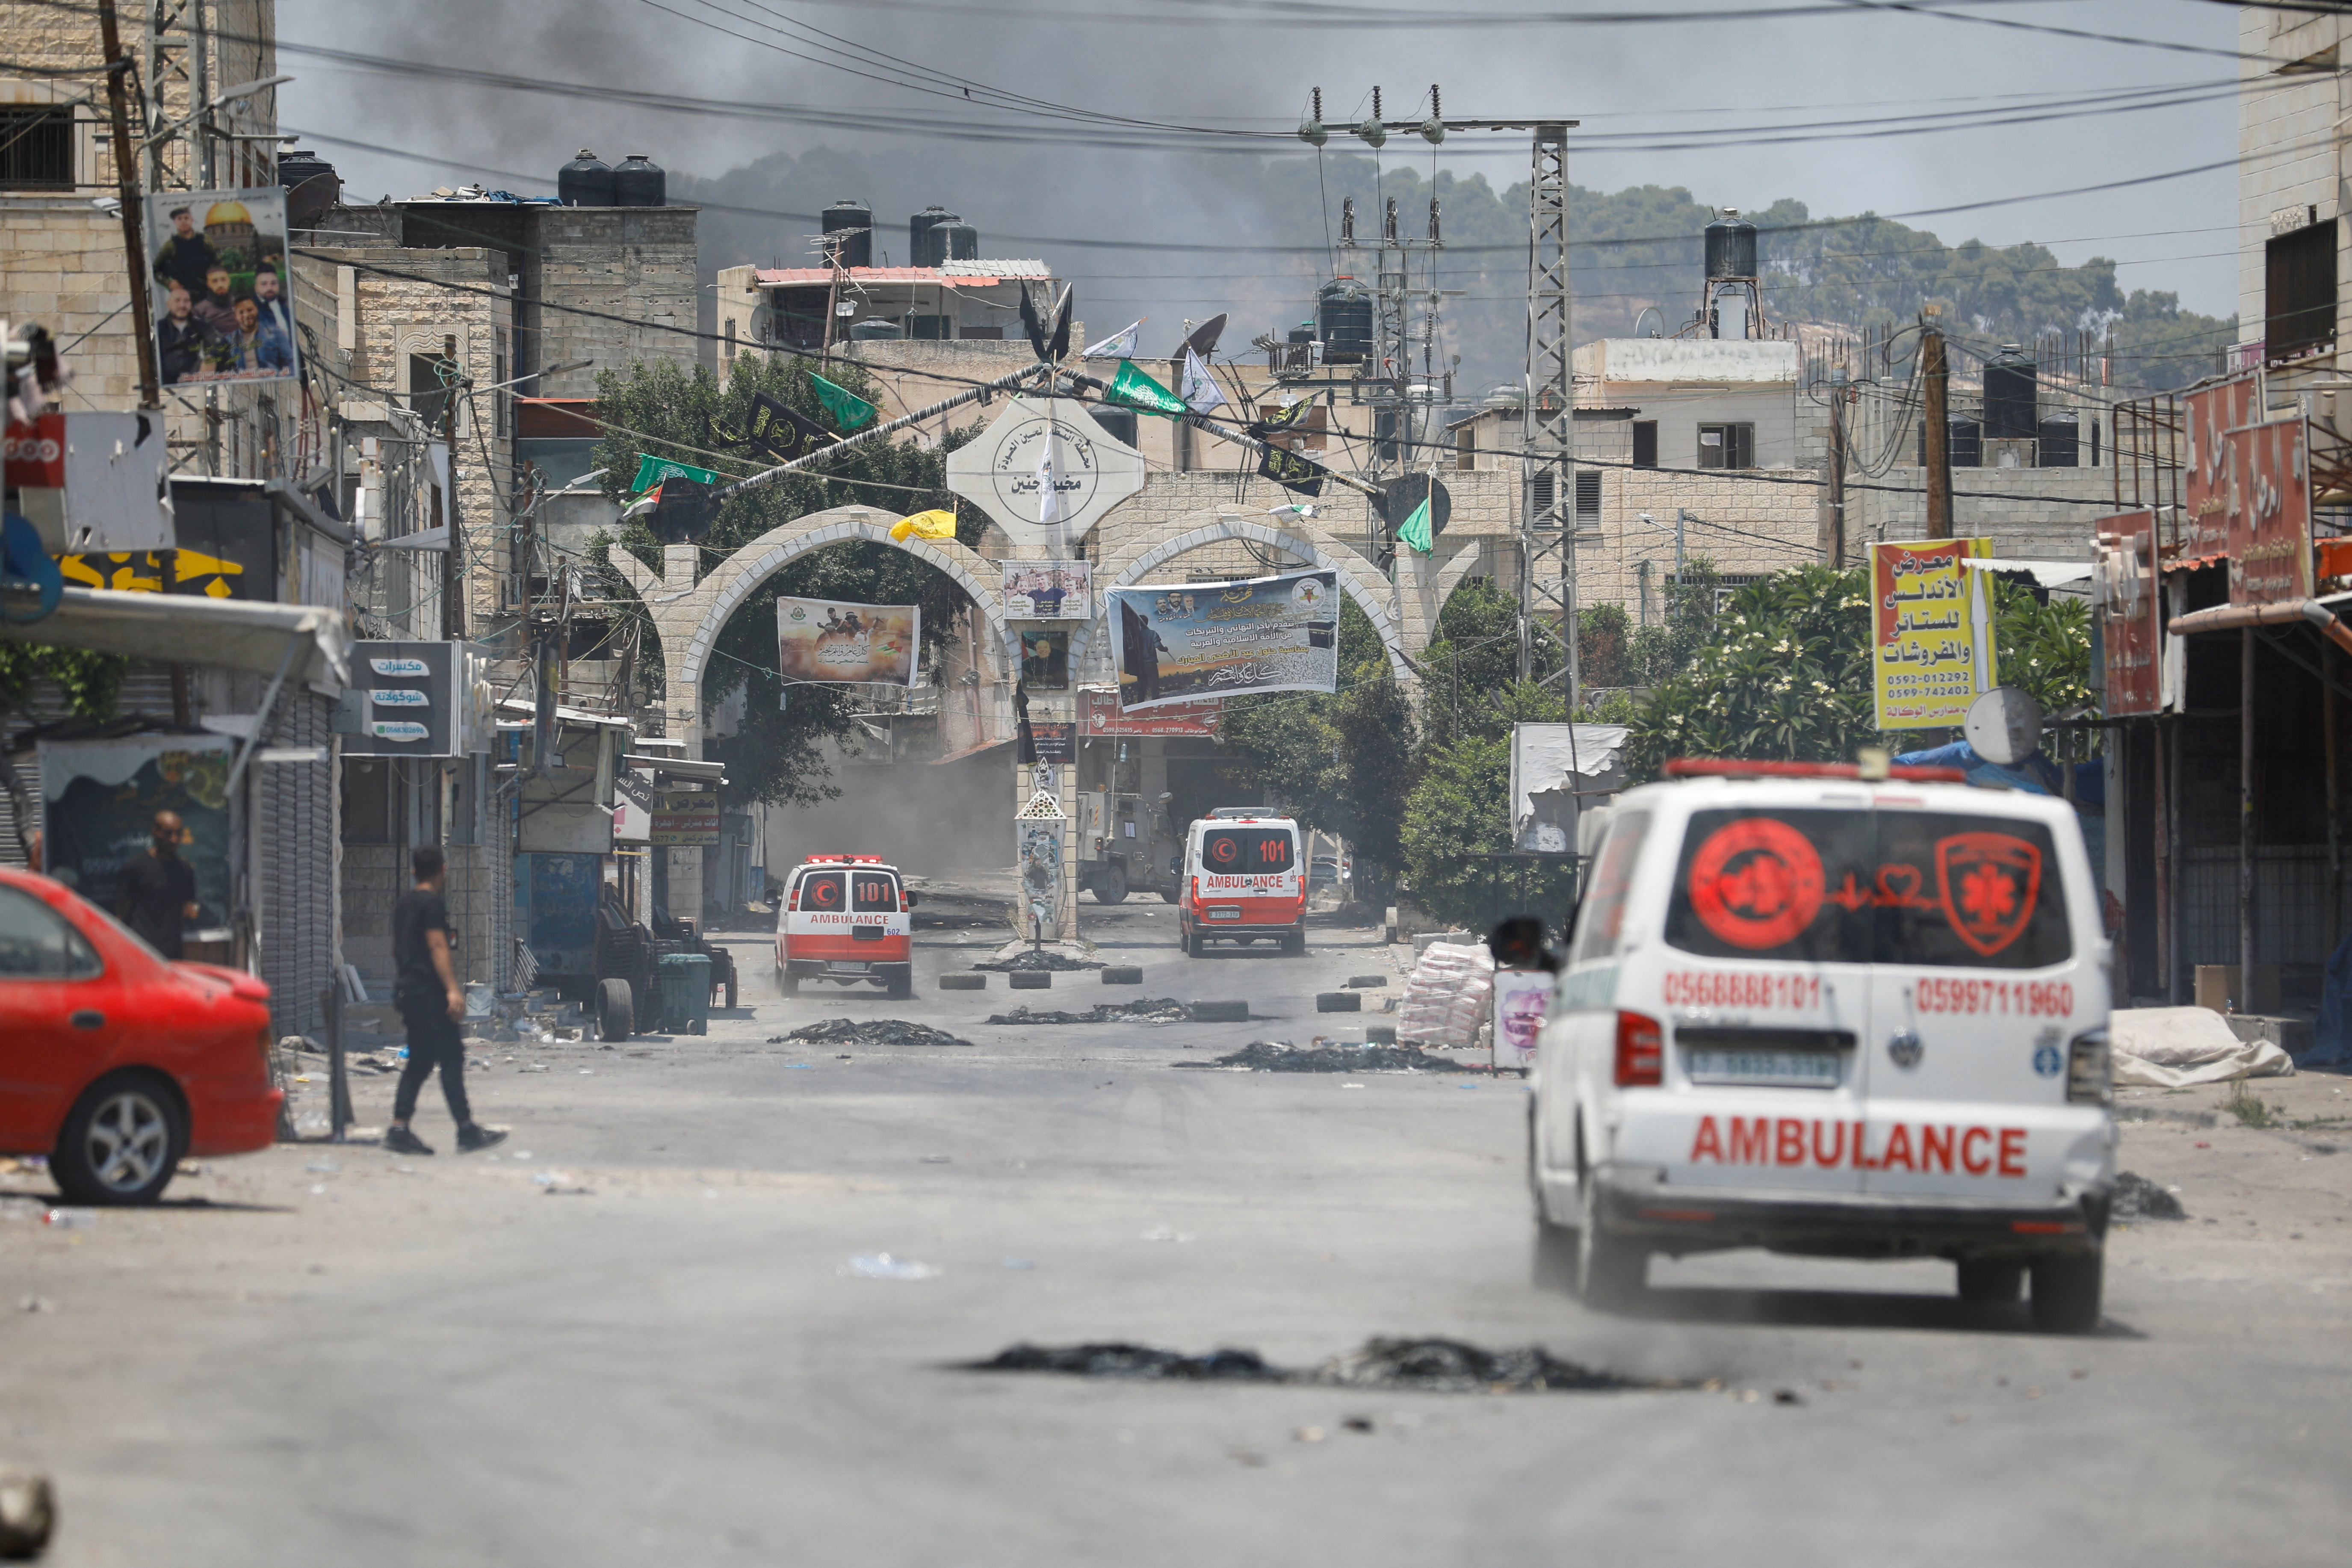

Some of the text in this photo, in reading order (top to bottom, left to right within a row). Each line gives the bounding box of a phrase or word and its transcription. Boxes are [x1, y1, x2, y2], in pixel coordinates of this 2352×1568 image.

[997, 439, 1019, 470] العودة
[1011, 475, 1040, 495] جنين
[1892, 550, 1953, 578] معرض
[1884, 574, 1965, 609] الأندلس
[1227, 623, 1255, 635] التهاني
[1256, 620, 1271, 631] بأحر
[1890, 609, 1960, 638] للستائر
[1185, 626, 1224, 637] والتبريكات
[1223, 633, 1258, 644] الإسلامية
[1260, 631, 1279, 640] الأمة
[856, 644, 870, 657] كل
[1191, 638, 1220, 649] والعربية
[1176, 644, 1309, 666] بمناسبة حلول عيد الأضحى المبارك
[1883, 640, 1971, 666] والمفروشات
[378, 661, 422, 672] مكسرات
[1887, 671, 1970, 685] 0592-012292
[375, 691, 421, 703] شوكولاتة
[1888, 686, 1970, 699] 0599-742402
[1092, 695, 1114, 708] طالب
[1886, 704, 1926, 718] الوكالة
[671, 795, 716, 812] معرض
[1260, 840, 1285, 862] 101
[1207, 875, 1283, 889] AMBULANCE
[857, 882, 889, 902] 101
[810, 914, 889, 924] AMBULANCE
[1662, 971, 2075, 1017] 0568888101 0599711960
[1689, 1115, 2028, 1178] AMBULANCE
